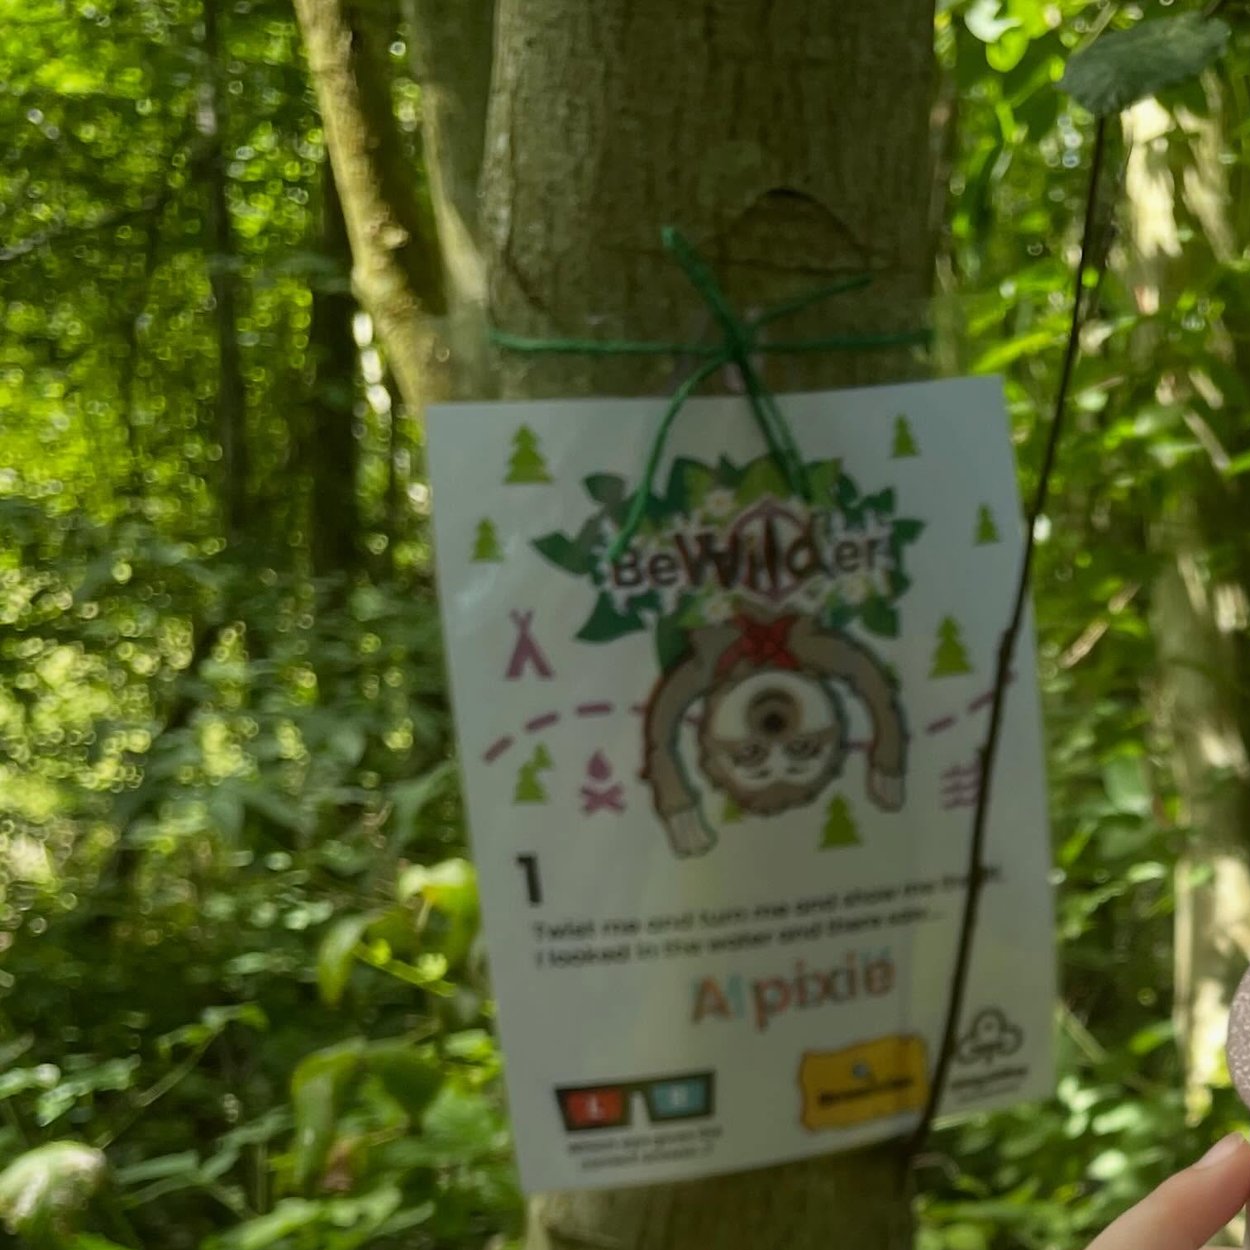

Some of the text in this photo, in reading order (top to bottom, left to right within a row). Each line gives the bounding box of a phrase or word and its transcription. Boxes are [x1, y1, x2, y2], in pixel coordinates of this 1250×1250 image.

[515, 851, 543, 905] 1
[533, 917, 594, 939] Twist
[602, 921, 640, 935] me
[647, 911, 694, 931] and
[753, 901, 789, 916] me
[796, 893, 838, 913] and
[903, 880, 936, 896] me
[549, 946, 631, 970] looked
[636, 941, 660, 960] in
[664, 937, 704, 956] the
[710, 928, 773, 950] water
[779, 921, 823, 943] and
